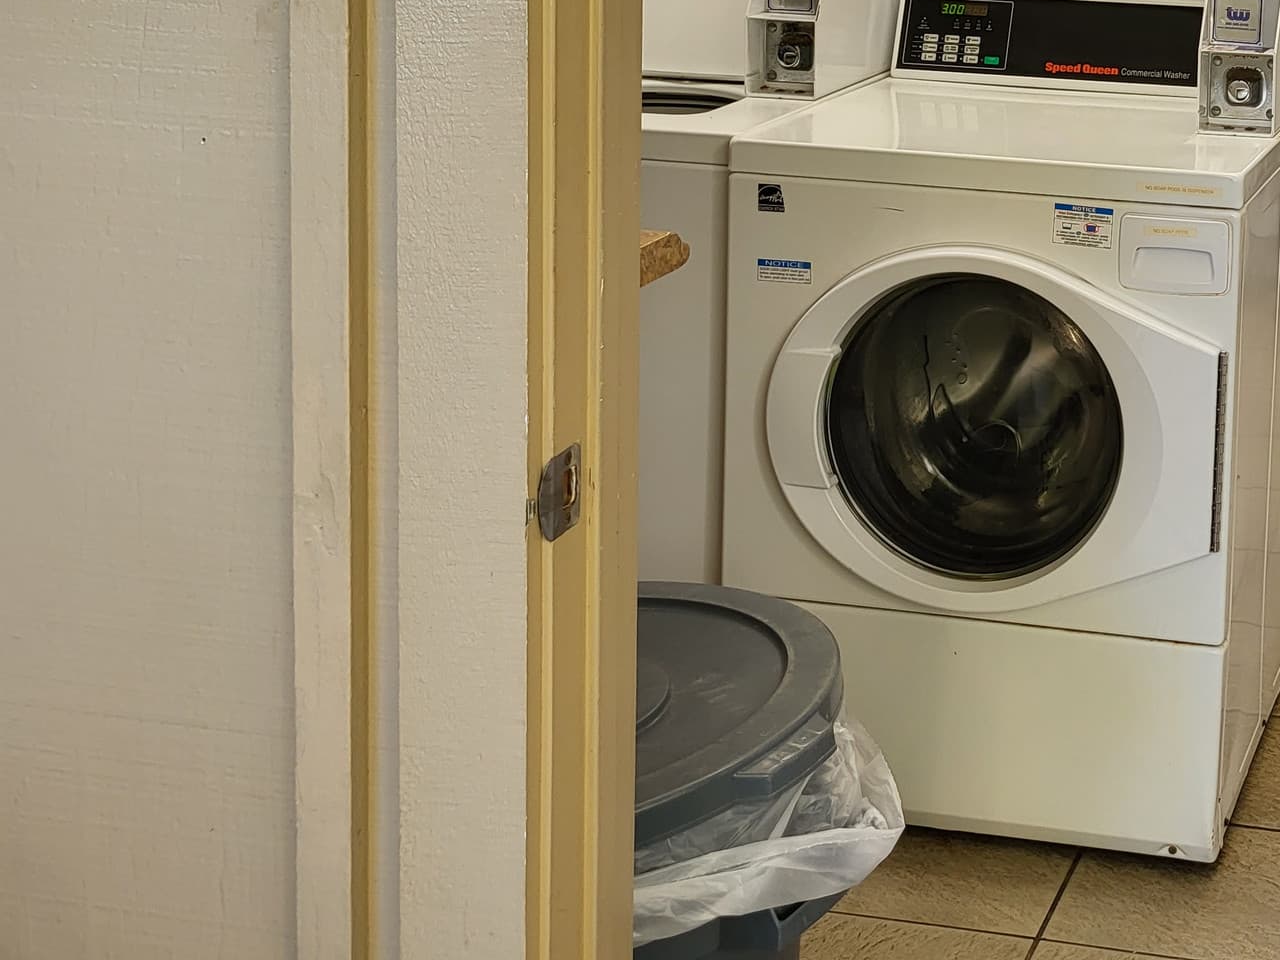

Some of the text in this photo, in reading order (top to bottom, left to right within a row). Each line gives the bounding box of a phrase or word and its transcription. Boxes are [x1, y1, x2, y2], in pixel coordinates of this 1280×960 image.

[1045, 62, 1190, 80] Speed Queen Commercial Washer
[765, 260, 802, 268] NOTICE
